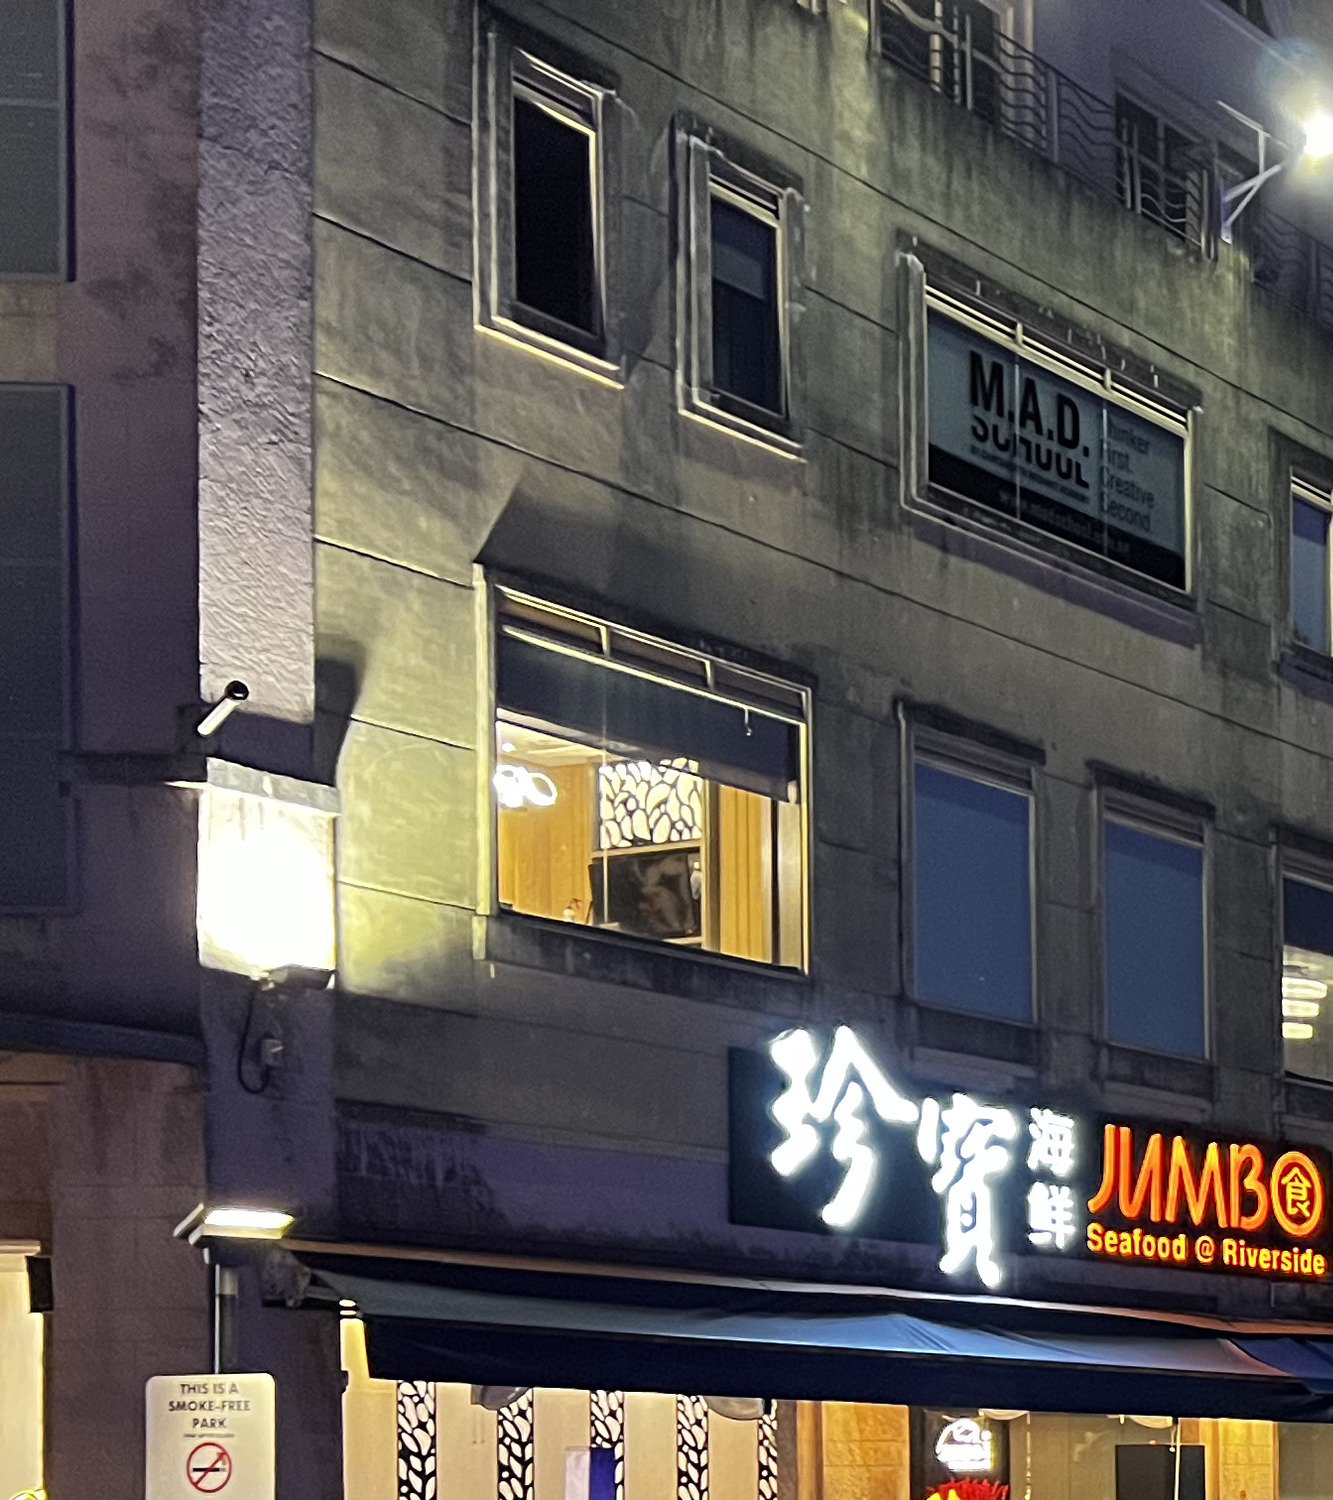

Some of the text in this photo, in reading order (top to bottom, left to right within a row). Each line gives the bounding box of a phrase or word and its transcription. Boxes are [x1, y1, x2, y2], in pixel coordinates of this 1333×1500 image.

[970, 350, 1090, 458] M.A.D.
[971, 416, 1089, 489] SCHOOL
[1087, 1123, 1323, 1237] JUMBO
[1086, 1222, 1326, 1275] Seafood @ Riverside
[168, 1400, 251, 1412] SMOKE-FREE
[180, 1383, 240, 1395] THIS IS A
[192, 1417, 228, 1430] PARK
